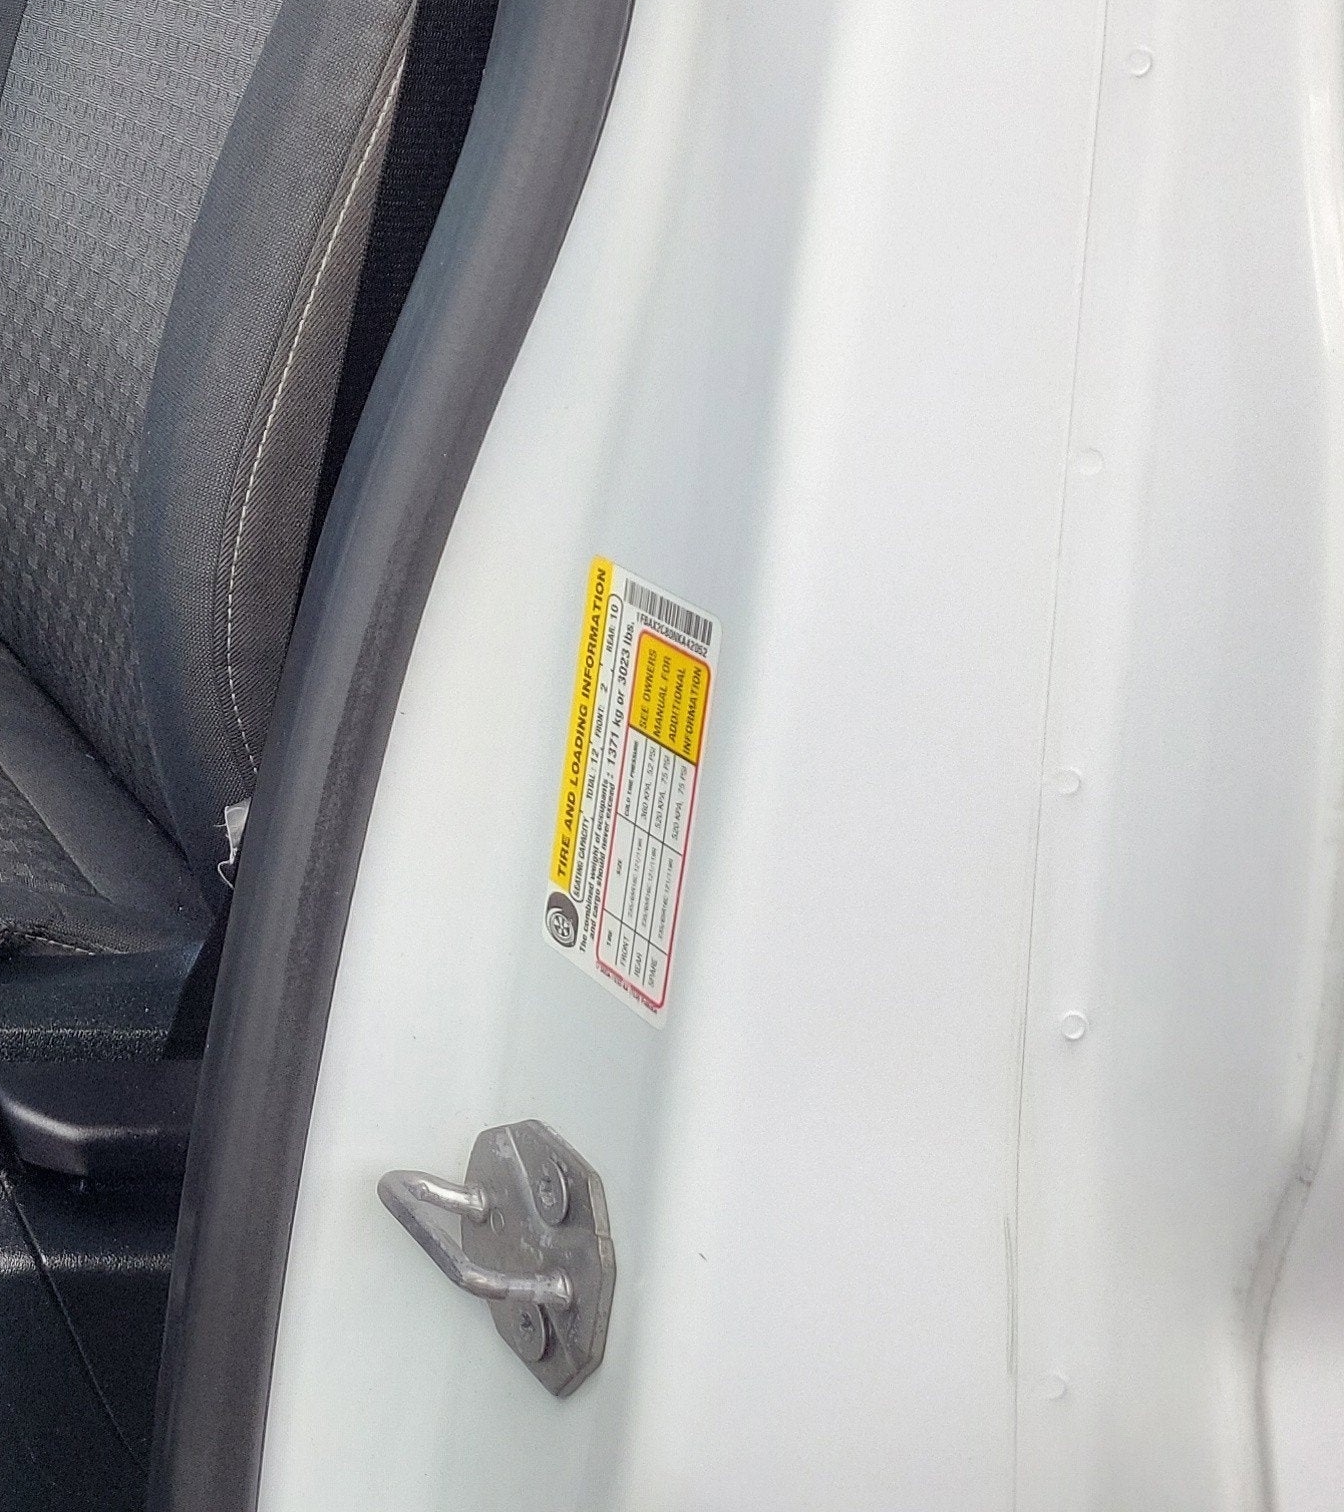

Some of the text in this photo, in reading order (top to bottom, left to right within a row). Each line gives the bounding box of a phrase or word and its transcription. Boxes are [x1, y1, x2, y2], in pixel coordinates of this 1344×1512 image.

[623, 619, 633, 645] lbs.
[617, 690, 624, 704] or
[618, 648, 629, 685] 3023
[640, 648, 656, 728] SEE OWNERS
[654, 655, 670, 737] MANUAL FOR
[557, 567, 606, 878] TIRE AND LOADING INFORMATION
[612, 708, 623, 727] kg
[669, 666, 684, 742] ADDITIONAL
[683, 666, 701, 754] INFORMATION
[573, 859, 583, 897] SEATING
[578, 816, 589, 859] CAPACITY
[591, 748, 598, 763] 12
[600, 682, 607, 692] 2
[610, 603, 618, 620] 10
[607, 731, 618, 766] 1371
[582, 881, 593, 931] combined
[590, 846, 599, 880] weight
[596, 778, 608, 831] occupants
[592, 888, 600, 918] cargo
[596, 851, 605, 886] should
[634, 952, 642, 977] REAR
[648, 957, 656, 987] SPARE
